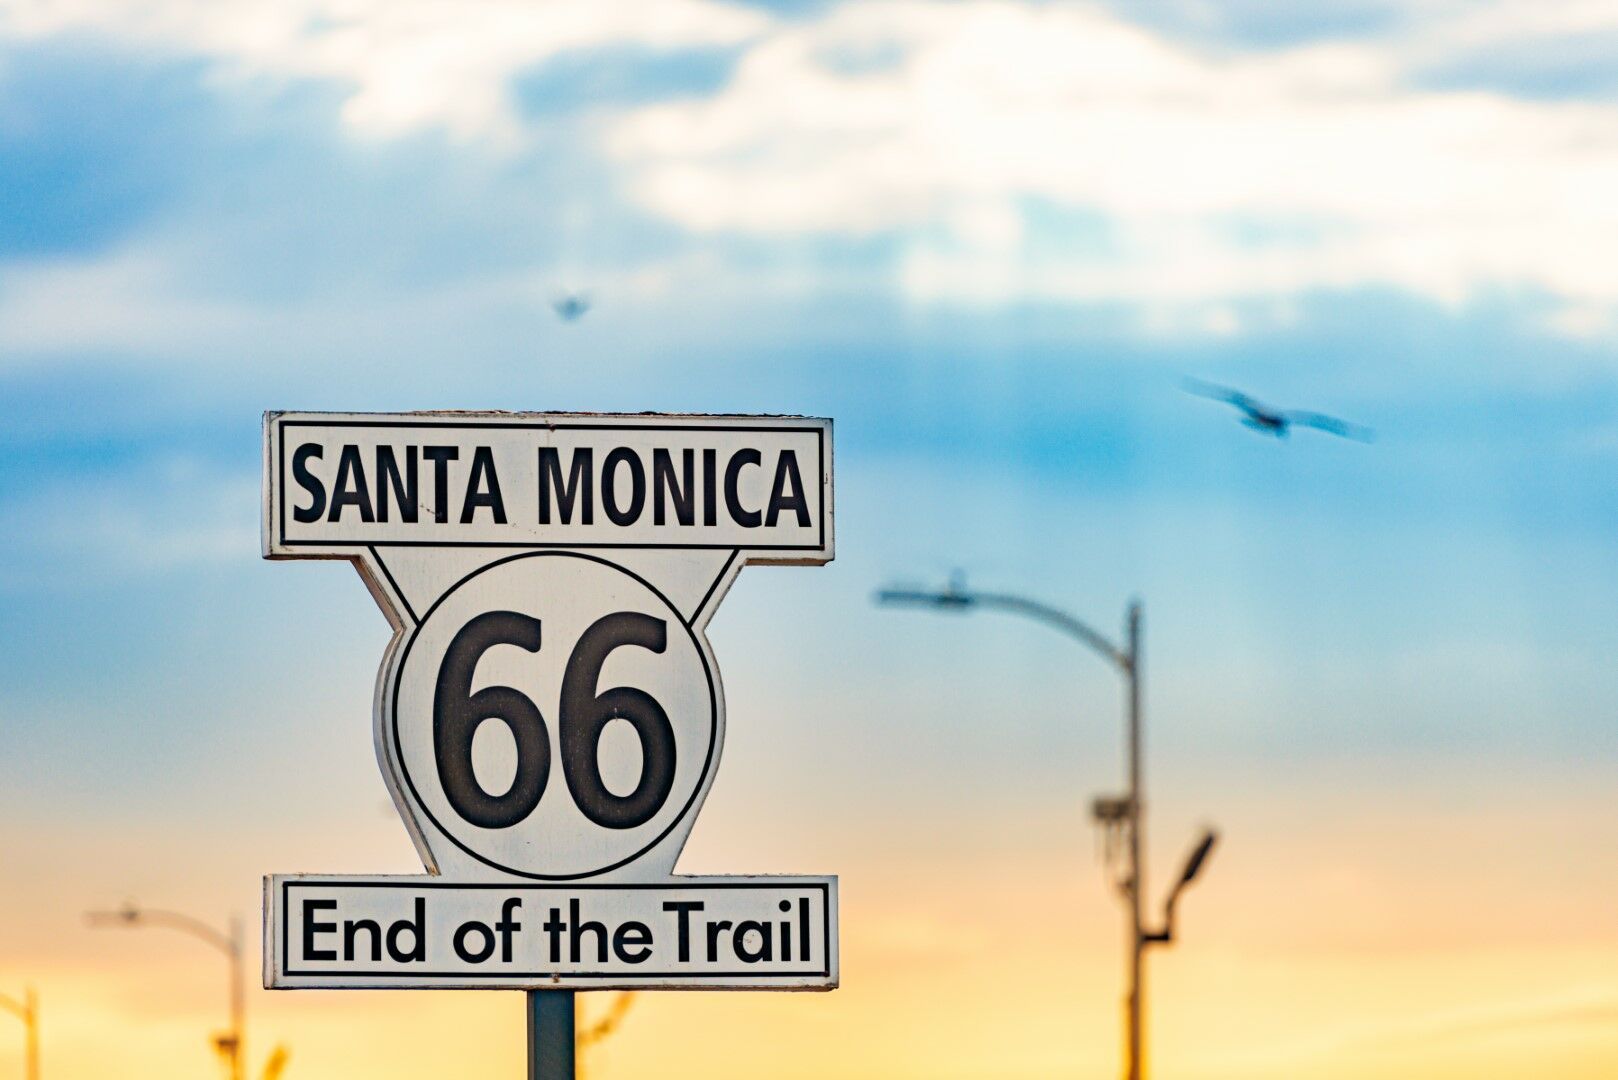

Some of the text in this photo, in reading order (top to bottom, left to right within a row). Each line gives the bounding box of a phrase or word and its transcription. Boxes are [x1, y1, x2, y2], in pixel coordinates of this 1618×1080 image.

[292, 443, 812, 528] SANTA MONICA
[433, 610, 677, 830] 66
[302, 896, 811, 965] End of the Trail
